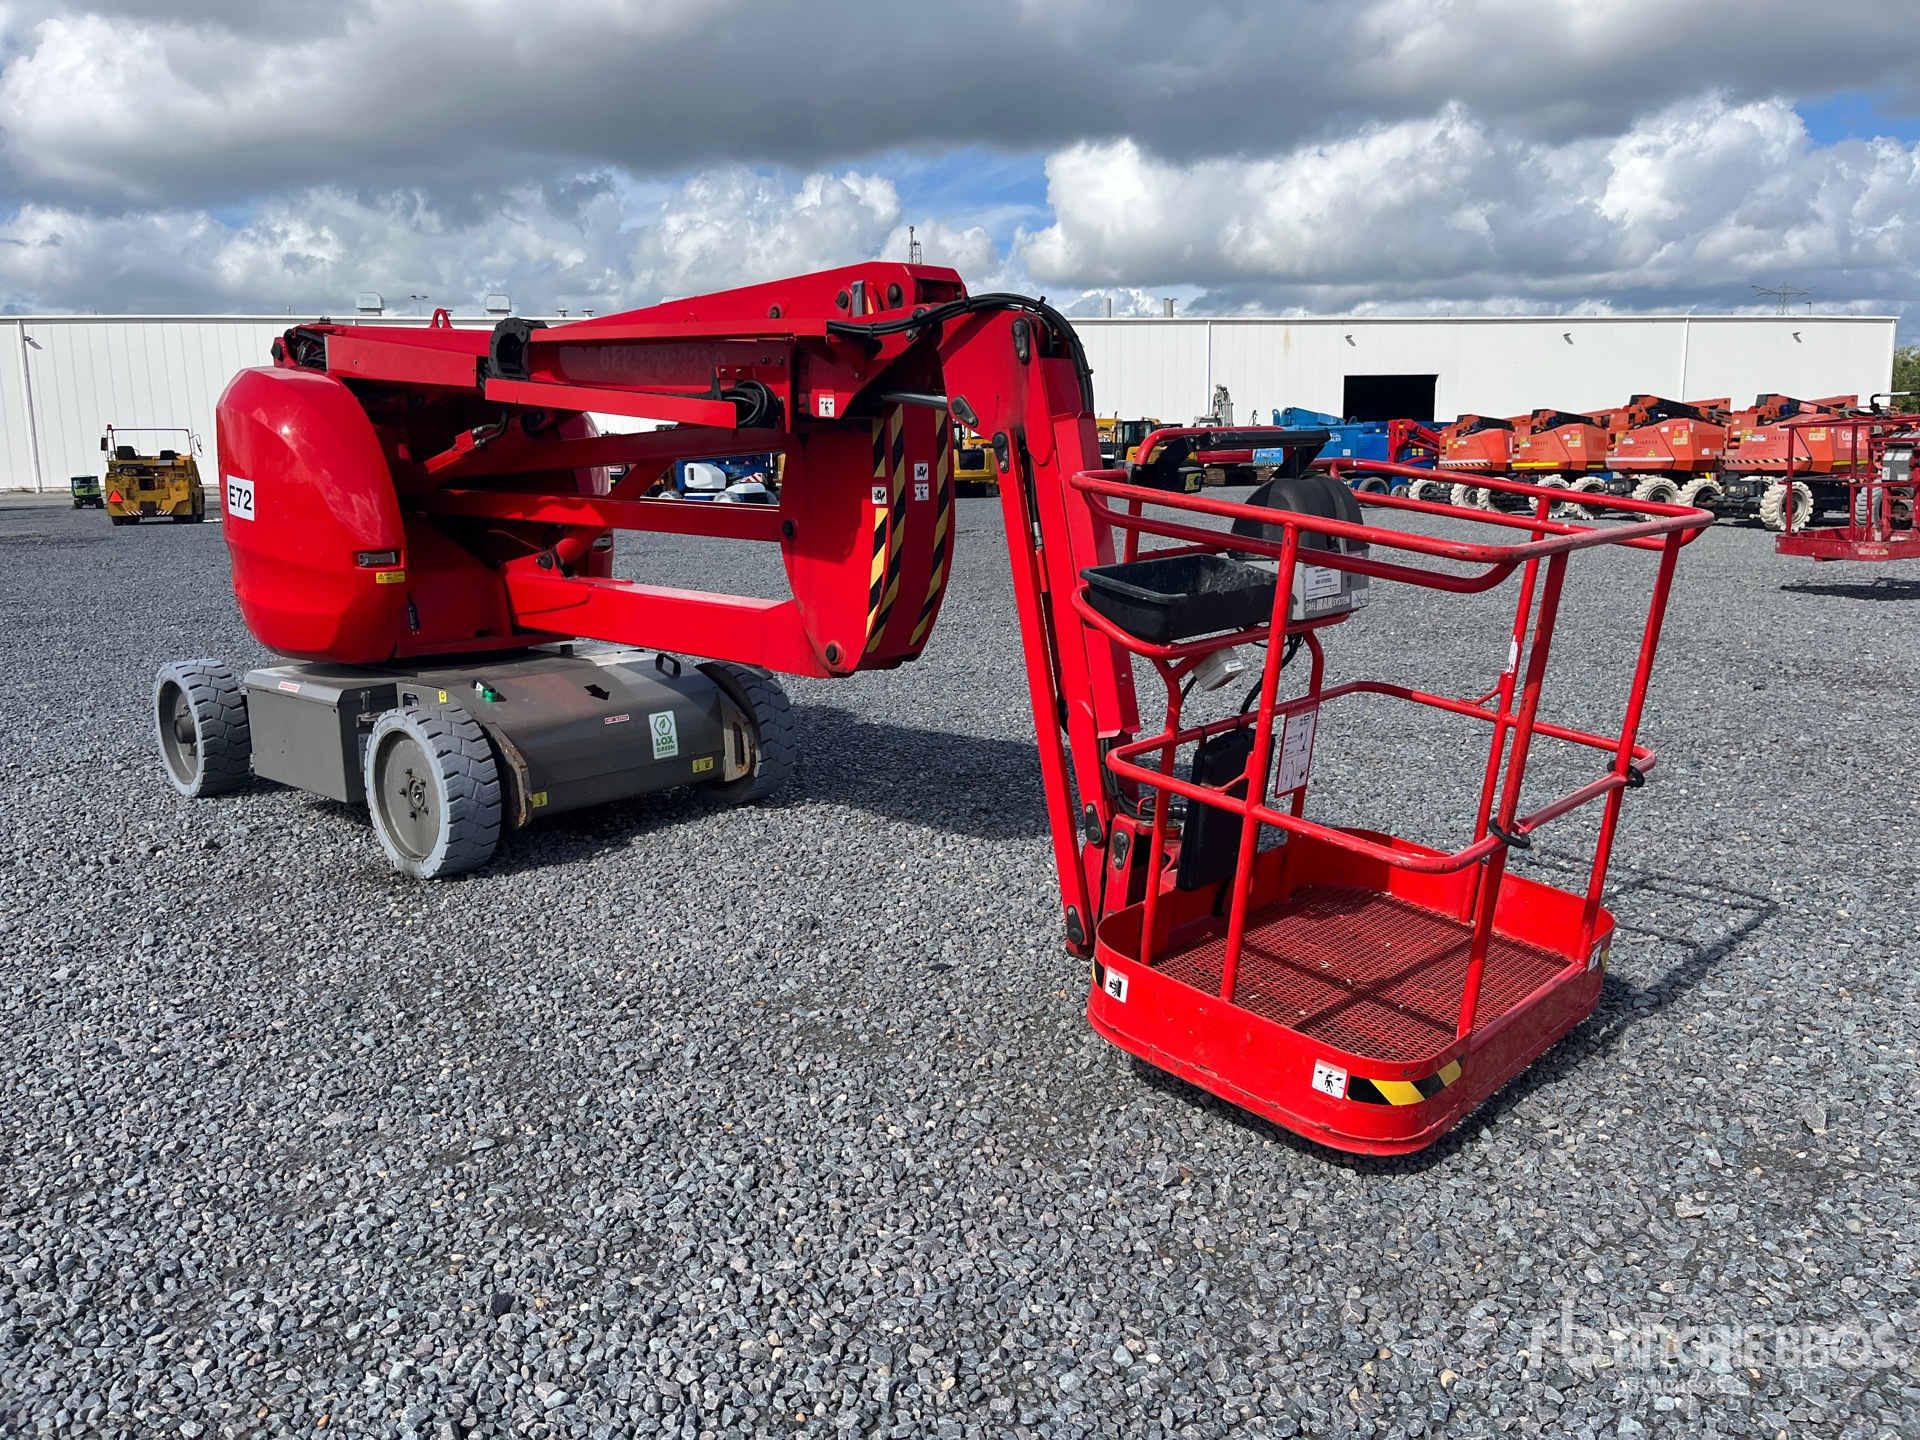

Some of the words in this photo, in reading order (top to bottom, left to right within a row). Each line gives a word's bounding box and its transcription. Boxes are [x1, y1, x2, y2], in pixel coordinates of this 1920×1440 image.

[229, 484, 252, 511] E72
[656, 735, 674, 747] LOX
[656, 744, 676, 753] GREEN
